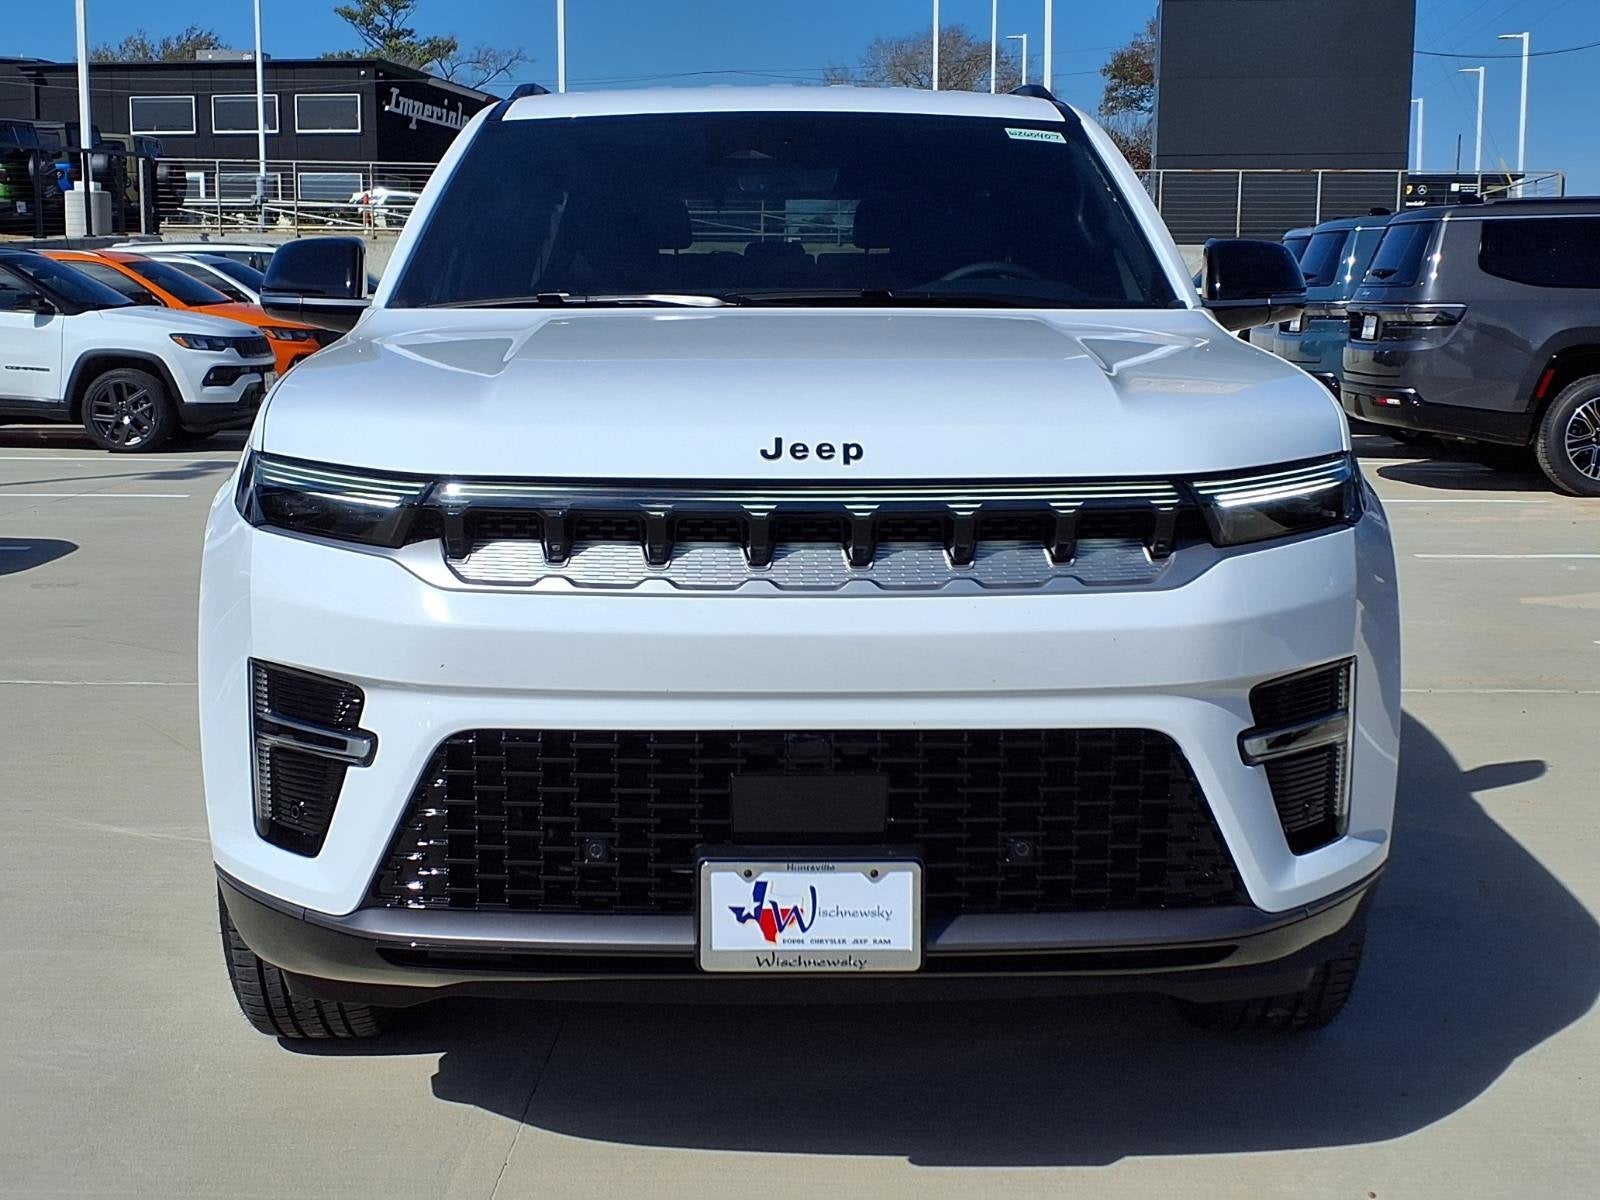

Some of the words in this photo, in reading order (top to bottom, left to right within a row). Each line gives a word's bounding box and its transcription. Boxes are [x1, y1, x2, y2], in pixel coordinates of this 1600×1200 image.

[760, 437, 864, 465] Jeep
[786, 863, 836, 871] Huntsville
[755, 952, 868, 969] Wischnewsky
